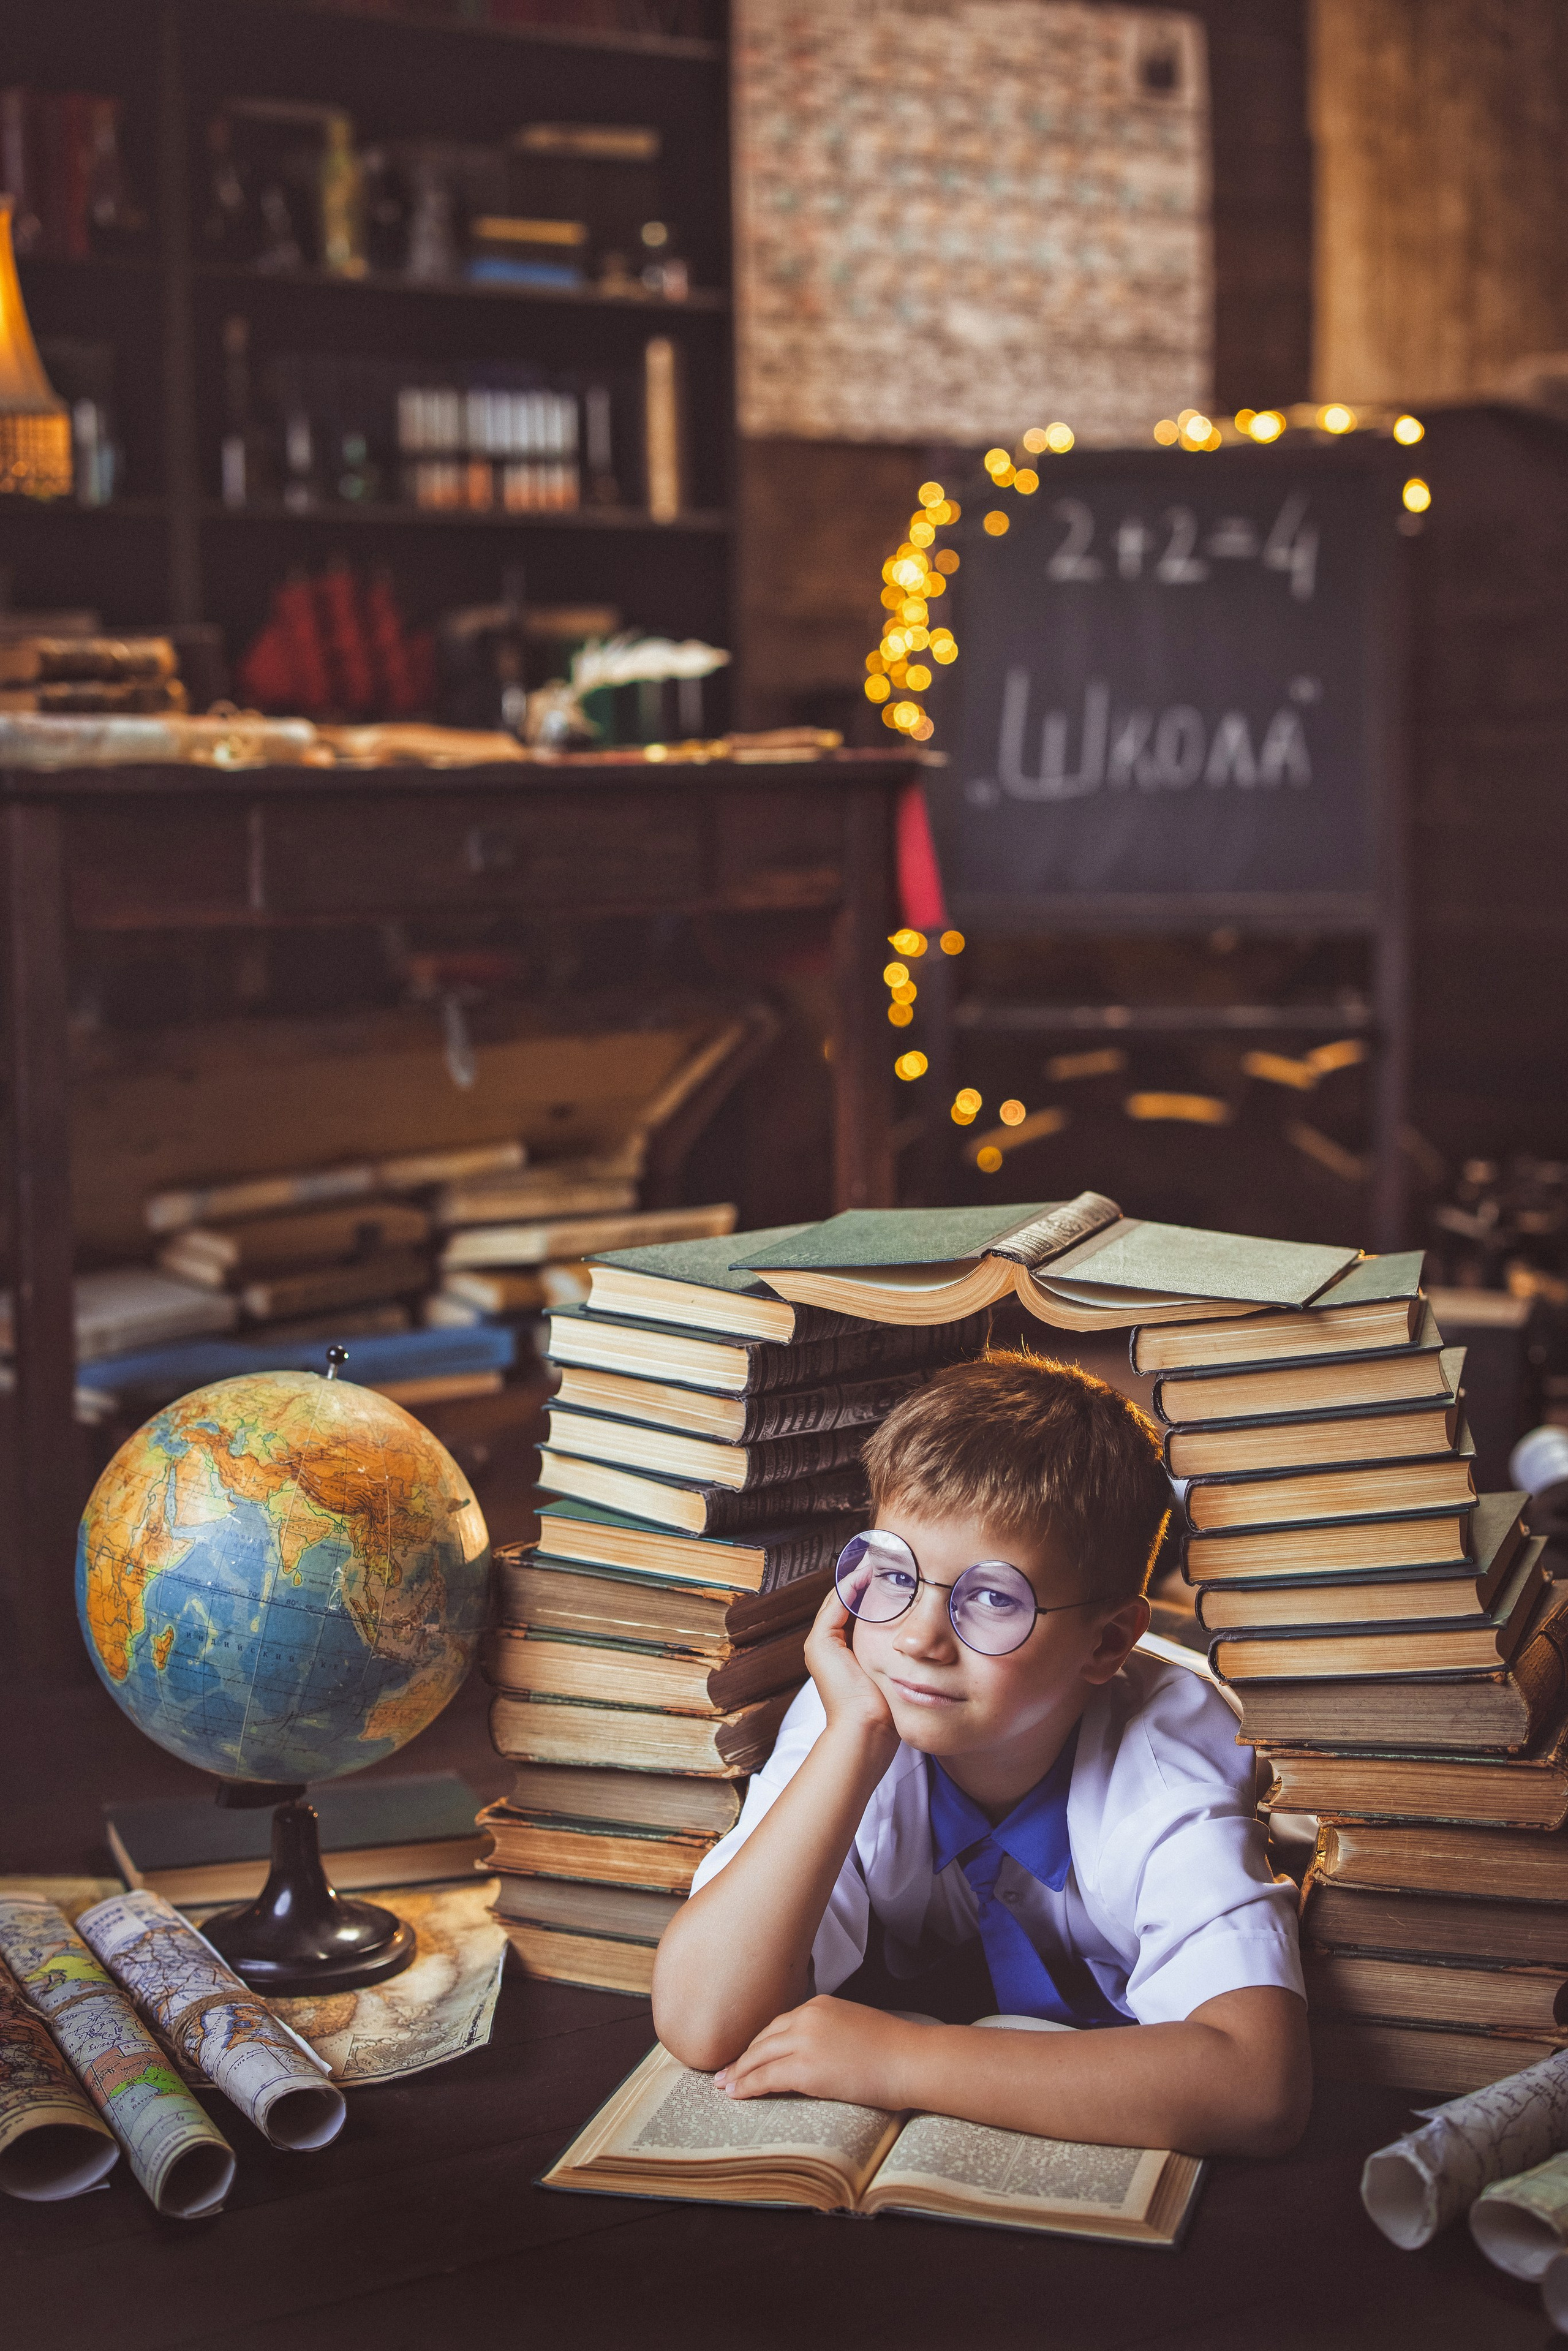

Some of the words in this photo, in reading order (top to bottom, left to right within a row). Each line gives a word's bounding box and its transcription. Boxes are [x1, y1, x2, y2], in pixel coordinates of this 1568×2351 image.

[1046, 492, 1319, 603] 2+2=4
[233, 1542, 256, 1553] МОРЕ
[186, 1632, 295, 1663] ИНДИЙСКИЙ
